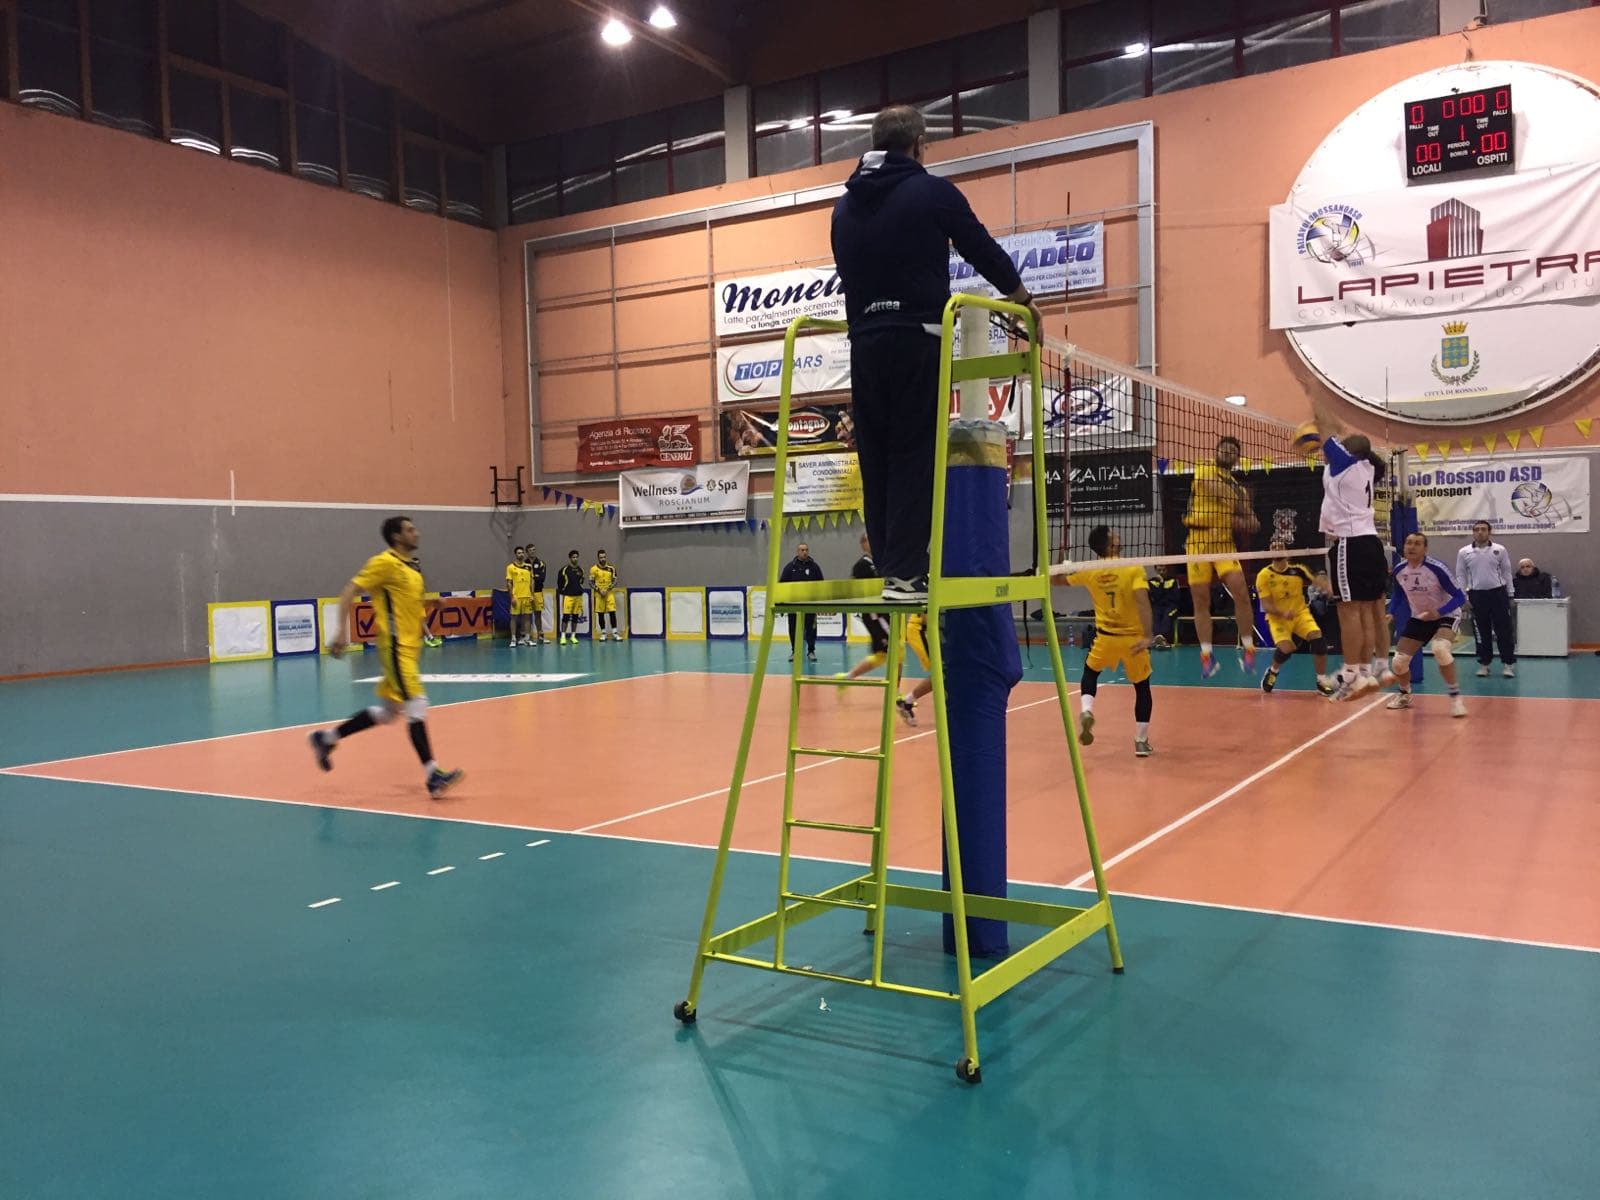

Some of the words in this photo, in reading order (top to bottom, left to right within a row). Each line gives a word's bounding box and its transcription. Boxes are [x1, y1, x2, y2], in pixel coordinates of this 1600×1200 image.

[1476, 152, 1508, 166] OSPITI
[1412, 162, 1442, 176] LOCALI
[738, 361, 780, 378] TOP
[791, 355, 824, 370] ARS
[788, 418, 827, 433] ontagna
[660, 452, 693, 461] GENERALI
[1435, 469, 1506, 485] Rossano
[1509, 465, 1542, 482] ASD
[632, 484, 678, 498] Wellness
[718, 480, 738, 494] Spa
[659, 497, 711, 506] ROSCIANUM
[1105, 591, 1116, 609] 7
